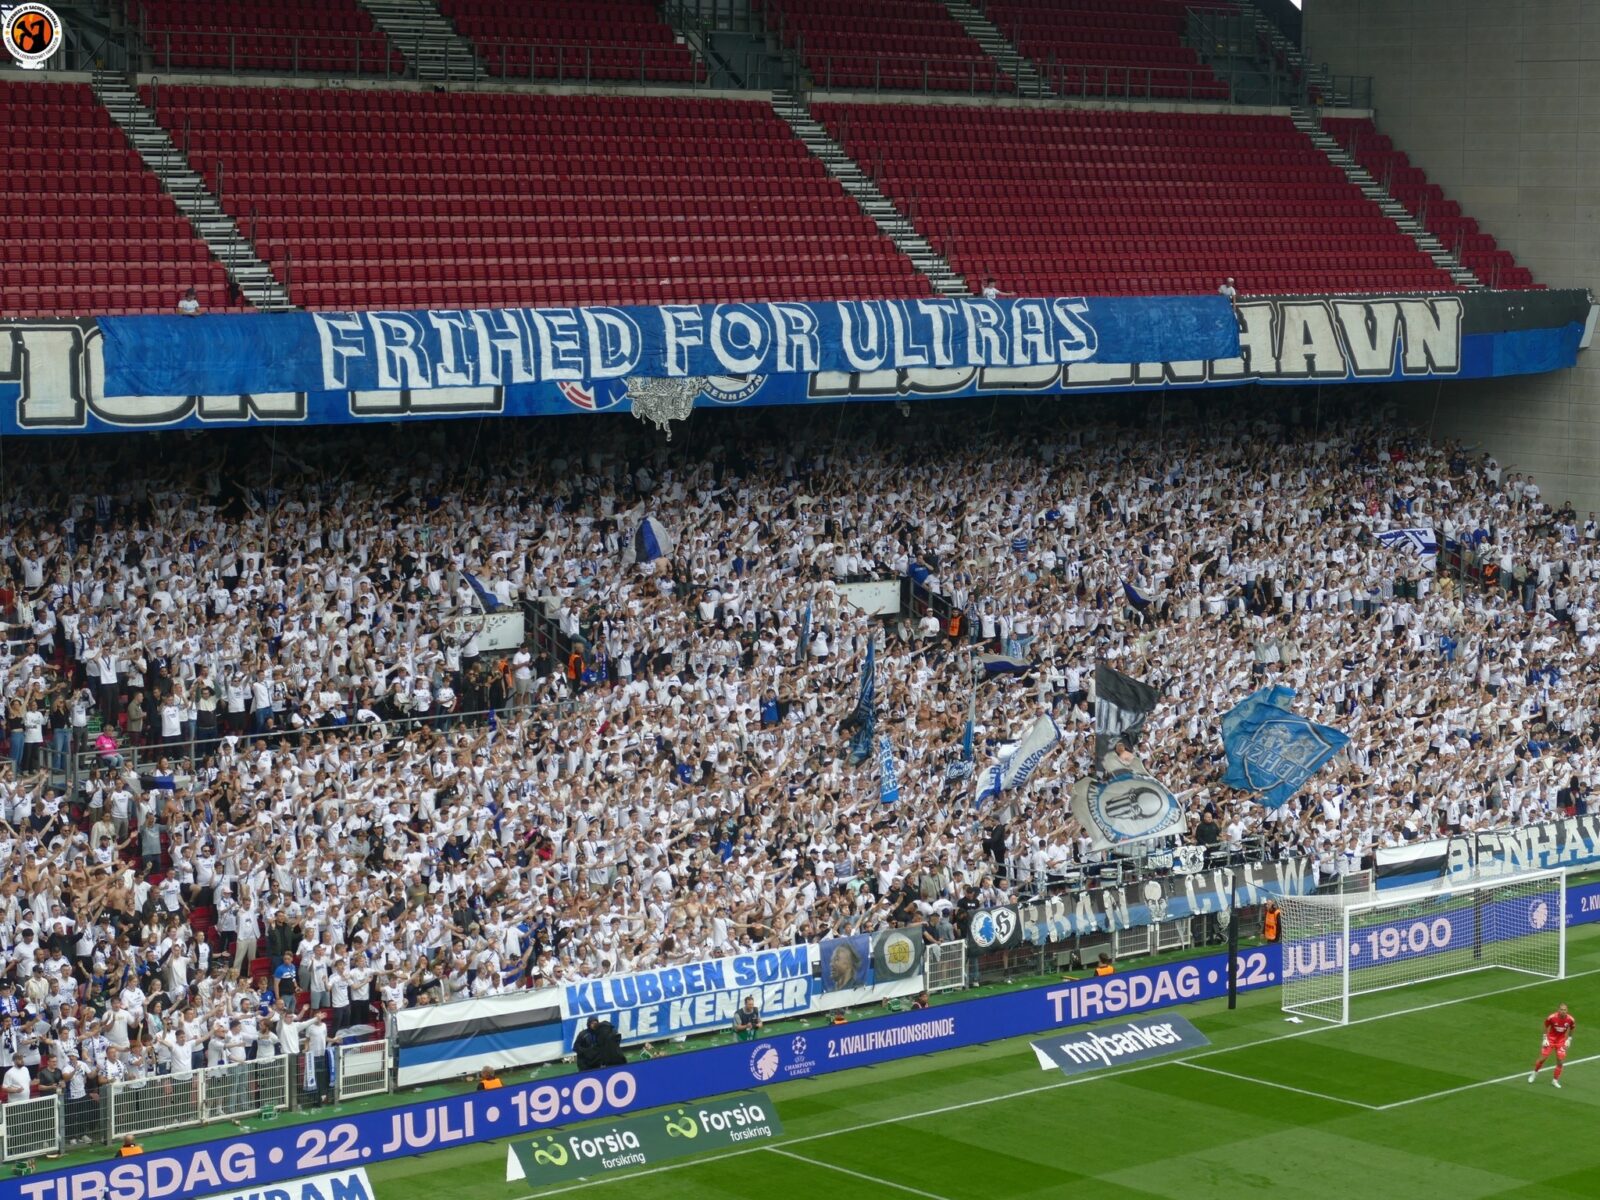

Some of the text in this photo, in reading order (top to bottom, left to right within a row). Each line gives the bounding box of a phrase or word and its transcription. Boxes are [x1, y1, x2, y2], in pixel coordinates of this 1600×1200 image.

[313, 305, 642, 391] FRIHED
[659, 301, 820, 377] FOR
[837, 296, 1098, 372] ULTRAS
[565, 945, 809, 1016] KLUBBEN SOM
[1047, 917, 1452, 1023] TIRSDAG 22. JULI 19:00
[828, 1017, 955, 1059] 2. KVALIFIKATIONSRUNDE
[1060, 1021, 1183, 1067] mybanker
[784, 1060, 816, 1072] CHAMPIONS
[789, 1067, 811, 1077] LEAGUE
[296, 1123, 372, 1170] 22.
[382, 1101, 475, 1154] JULI
[510, 1071, 637, 1127] 19:00
[698, 1103, 766, 1133] forsia
[729, 1123, 772, 1142] forsikring
[568, 1128, 640, 1160] forsia
[602, 1150, 646, 1169] forsikring
